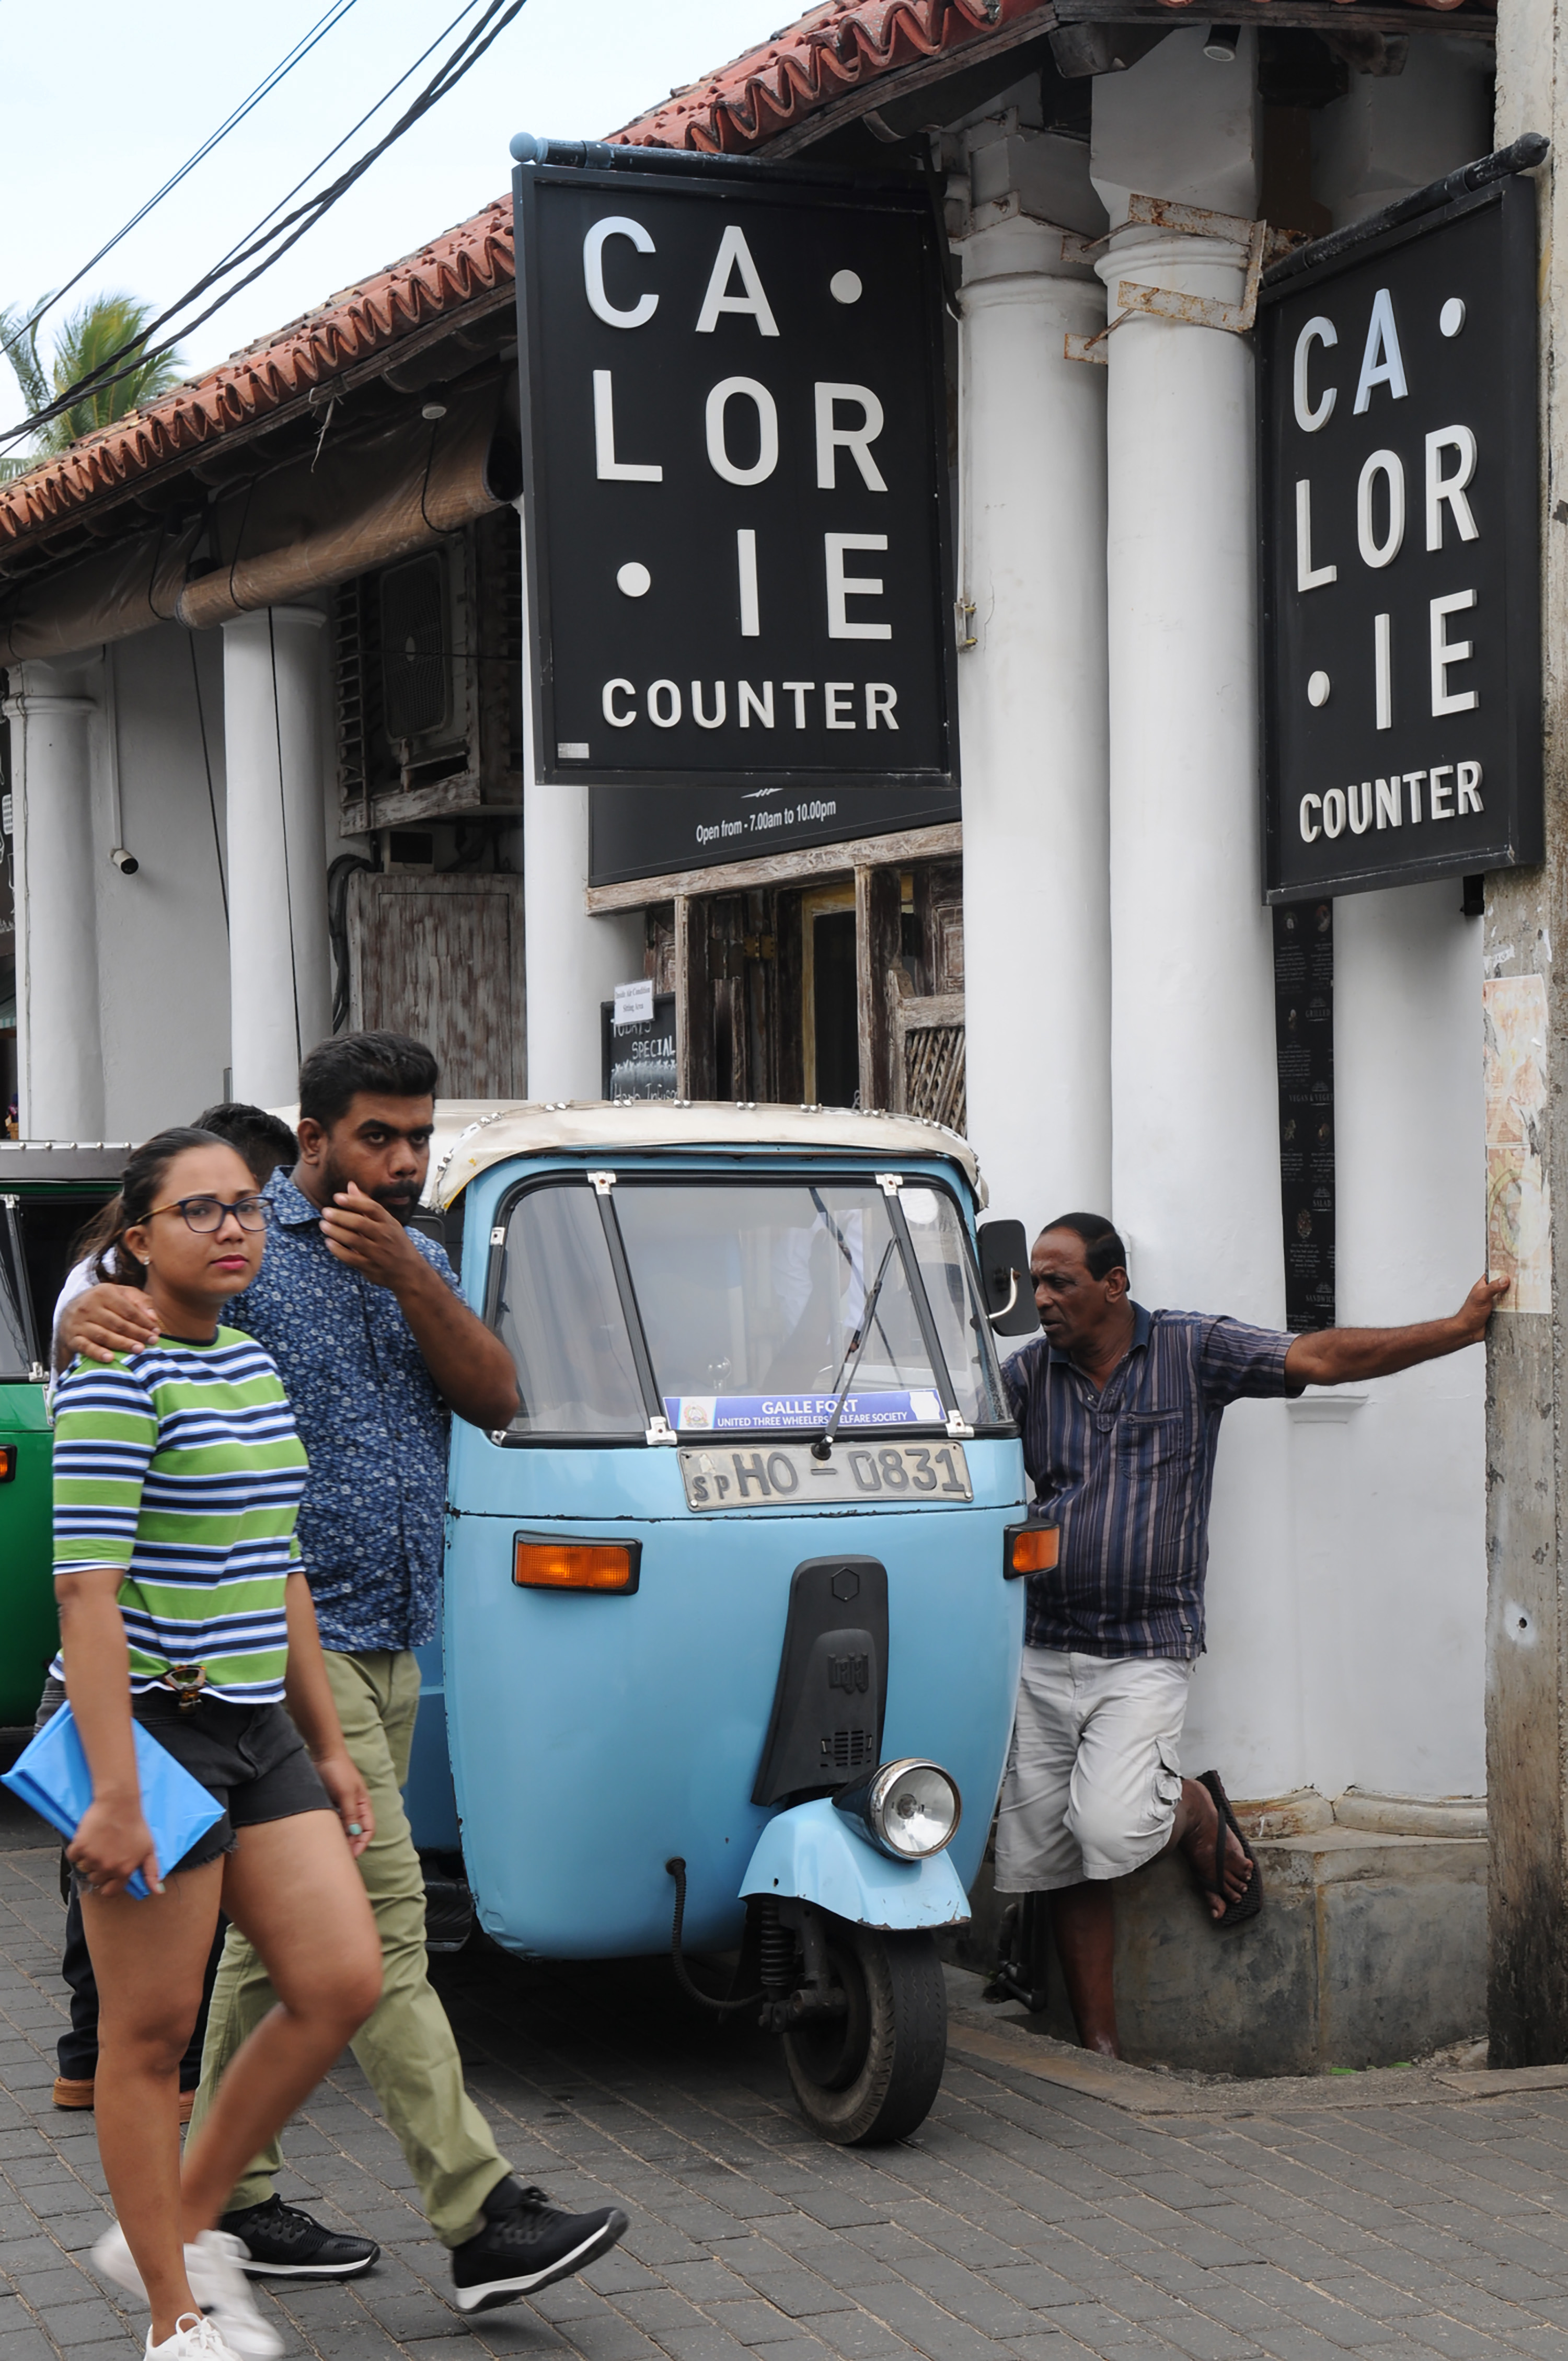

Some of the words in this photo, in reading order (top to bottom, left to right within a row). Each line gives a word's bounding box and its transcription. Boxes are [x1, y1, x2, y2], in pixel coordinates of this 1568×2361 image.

[602, 678, 899, 730] COUNTER
[696, 825, 720, 845] Open
[721, 820, 742, 837] from
[750, 811, 782, 831] 7.00am
[784, 808, 794, 824] to
[797, 800, 836, 821] 10.00pm
[1299, 761, 1484, 843] COUNTER
[717, 1418, 751, 1427] UNITED
[752, 1416, 781, 1426] THREE
[782, 1415, 829, 1425] WHEELERS
[830, 1413, 870, 1424] ELFARE
[872, 1412, 907, 1422] SOCIETY
[762, 1400, 812, 1414] GALLE
[732, 1452, 799, 1496] HO
[847, 1448, 965, 1492] 0831
